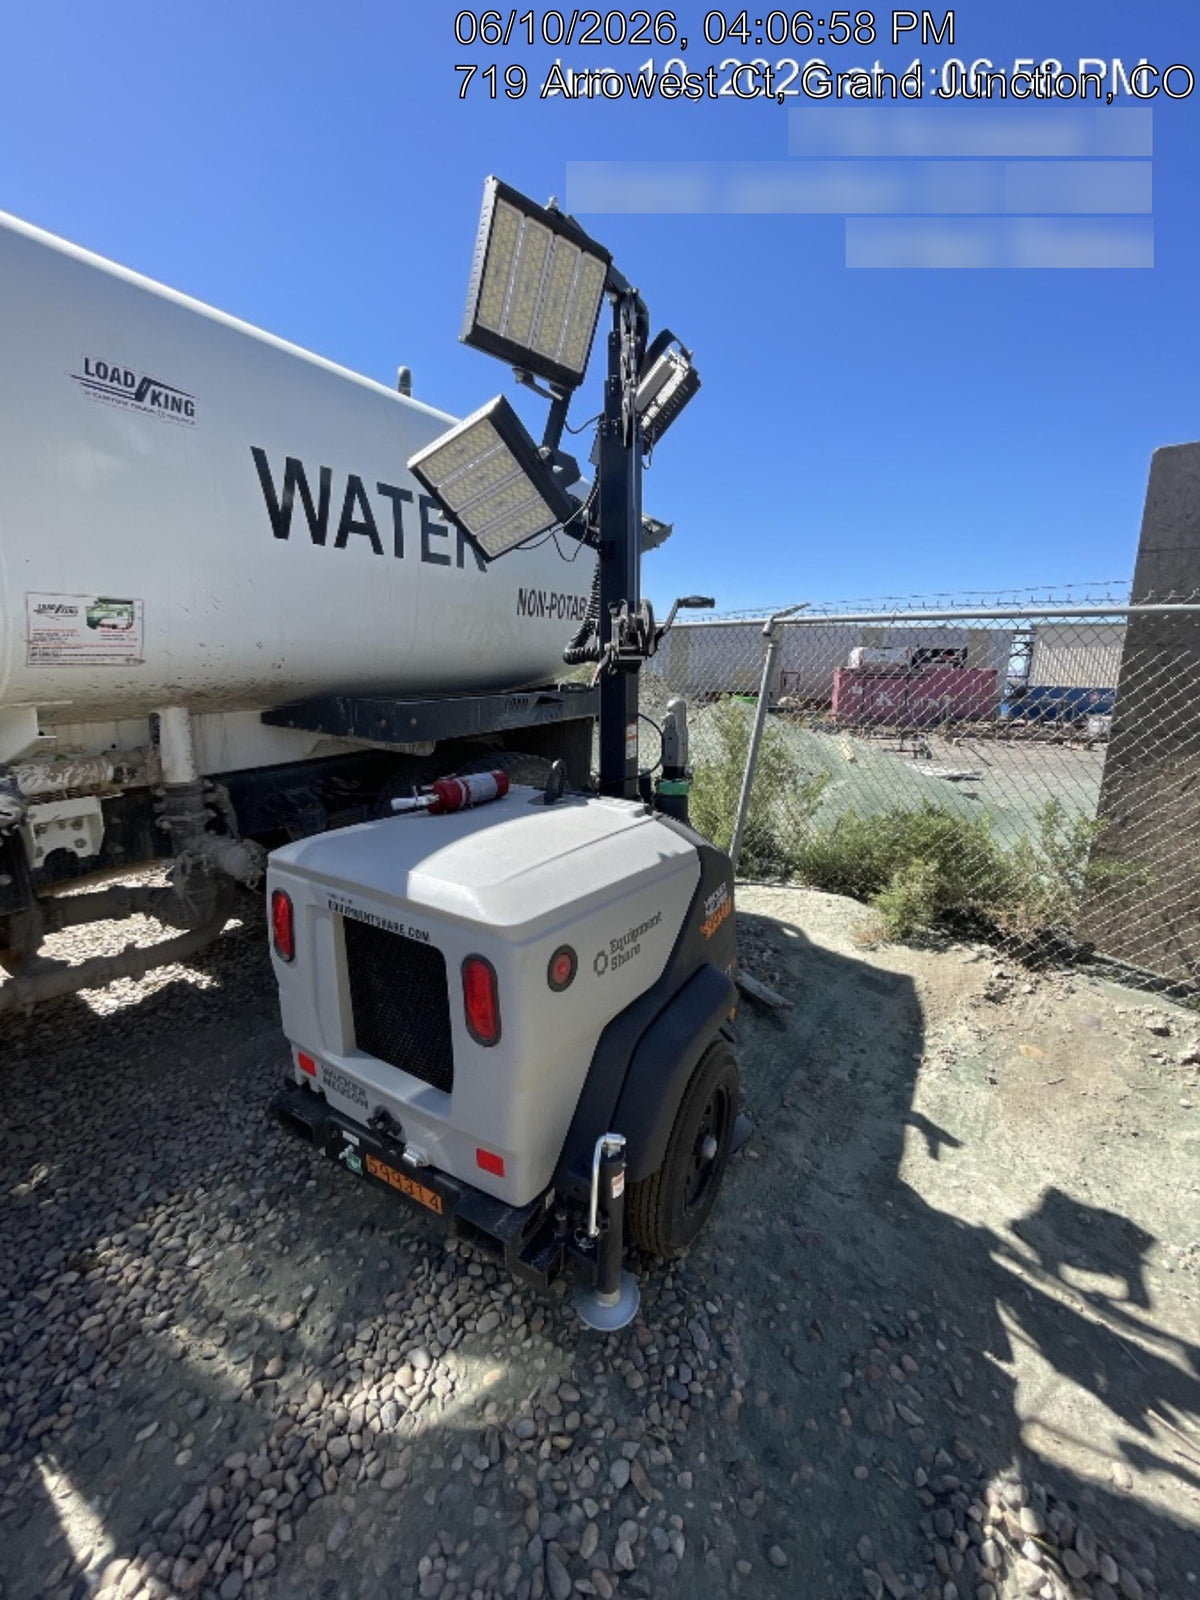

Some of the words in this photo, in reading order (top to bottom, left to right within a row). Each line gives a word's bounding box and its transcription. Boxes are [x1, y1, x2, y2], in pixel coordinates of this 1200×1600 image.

[84, 357, 136, 389] LOAD
[151, 388, 195, 418] KING
[516, 587, 588, 620] NON-POTAB
[609, 910, 662, 955] Equipment
[611, 944, 641, 972] Share
